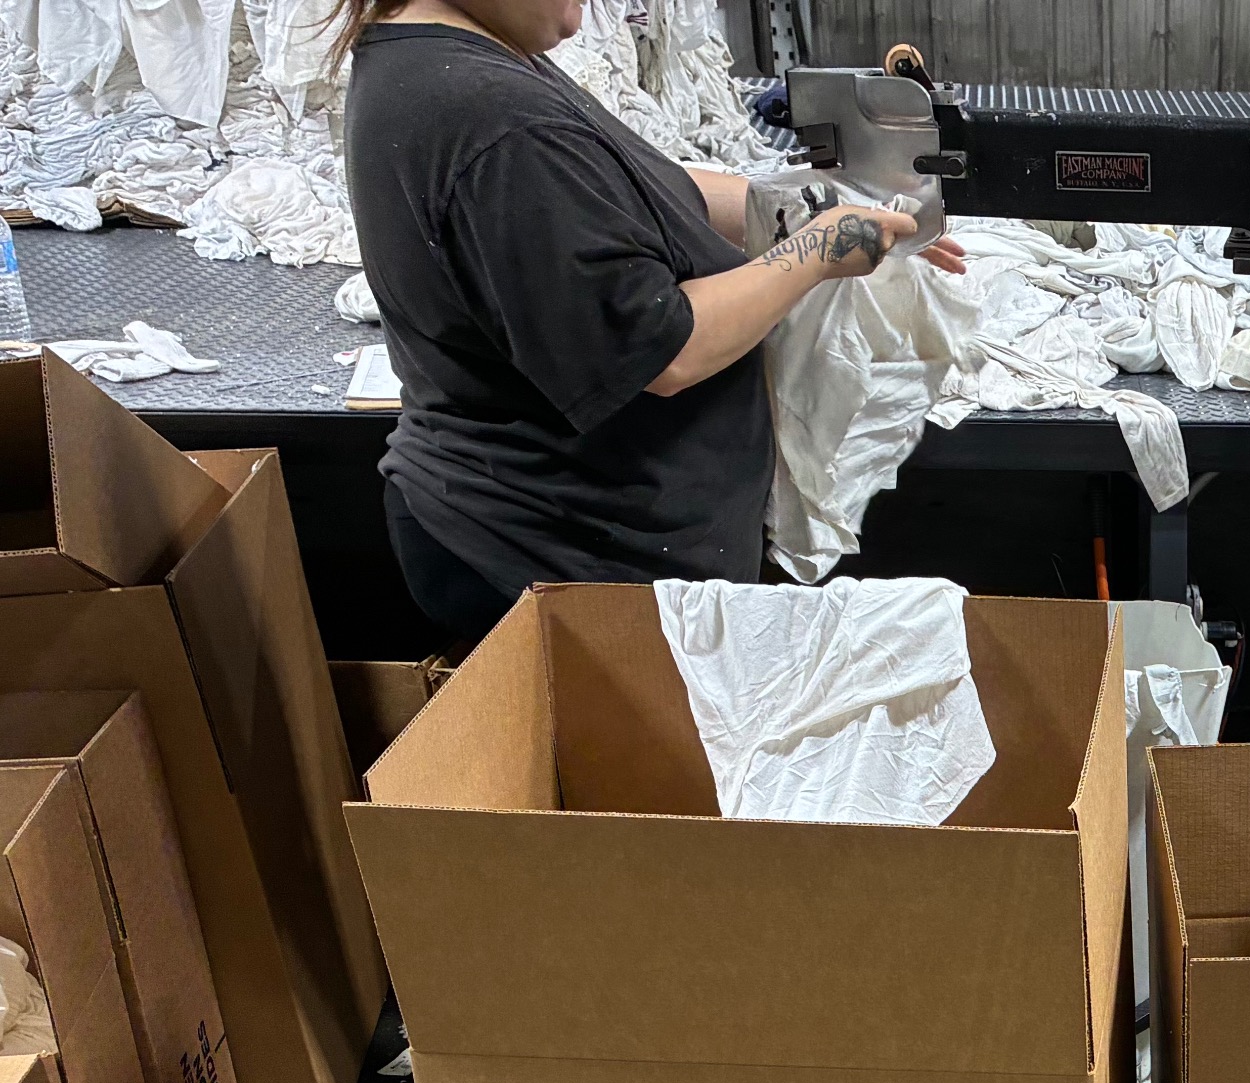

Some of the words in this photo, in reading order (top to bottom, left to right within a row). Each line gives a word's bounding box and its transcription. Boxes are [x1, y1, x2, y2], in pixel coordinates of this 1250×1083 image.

[1062, 155, 1103, 179] EASTMAN
[1105, 157, 1145, 181] MACHINE
[1081, 169, 1127, 180] COMPANY
